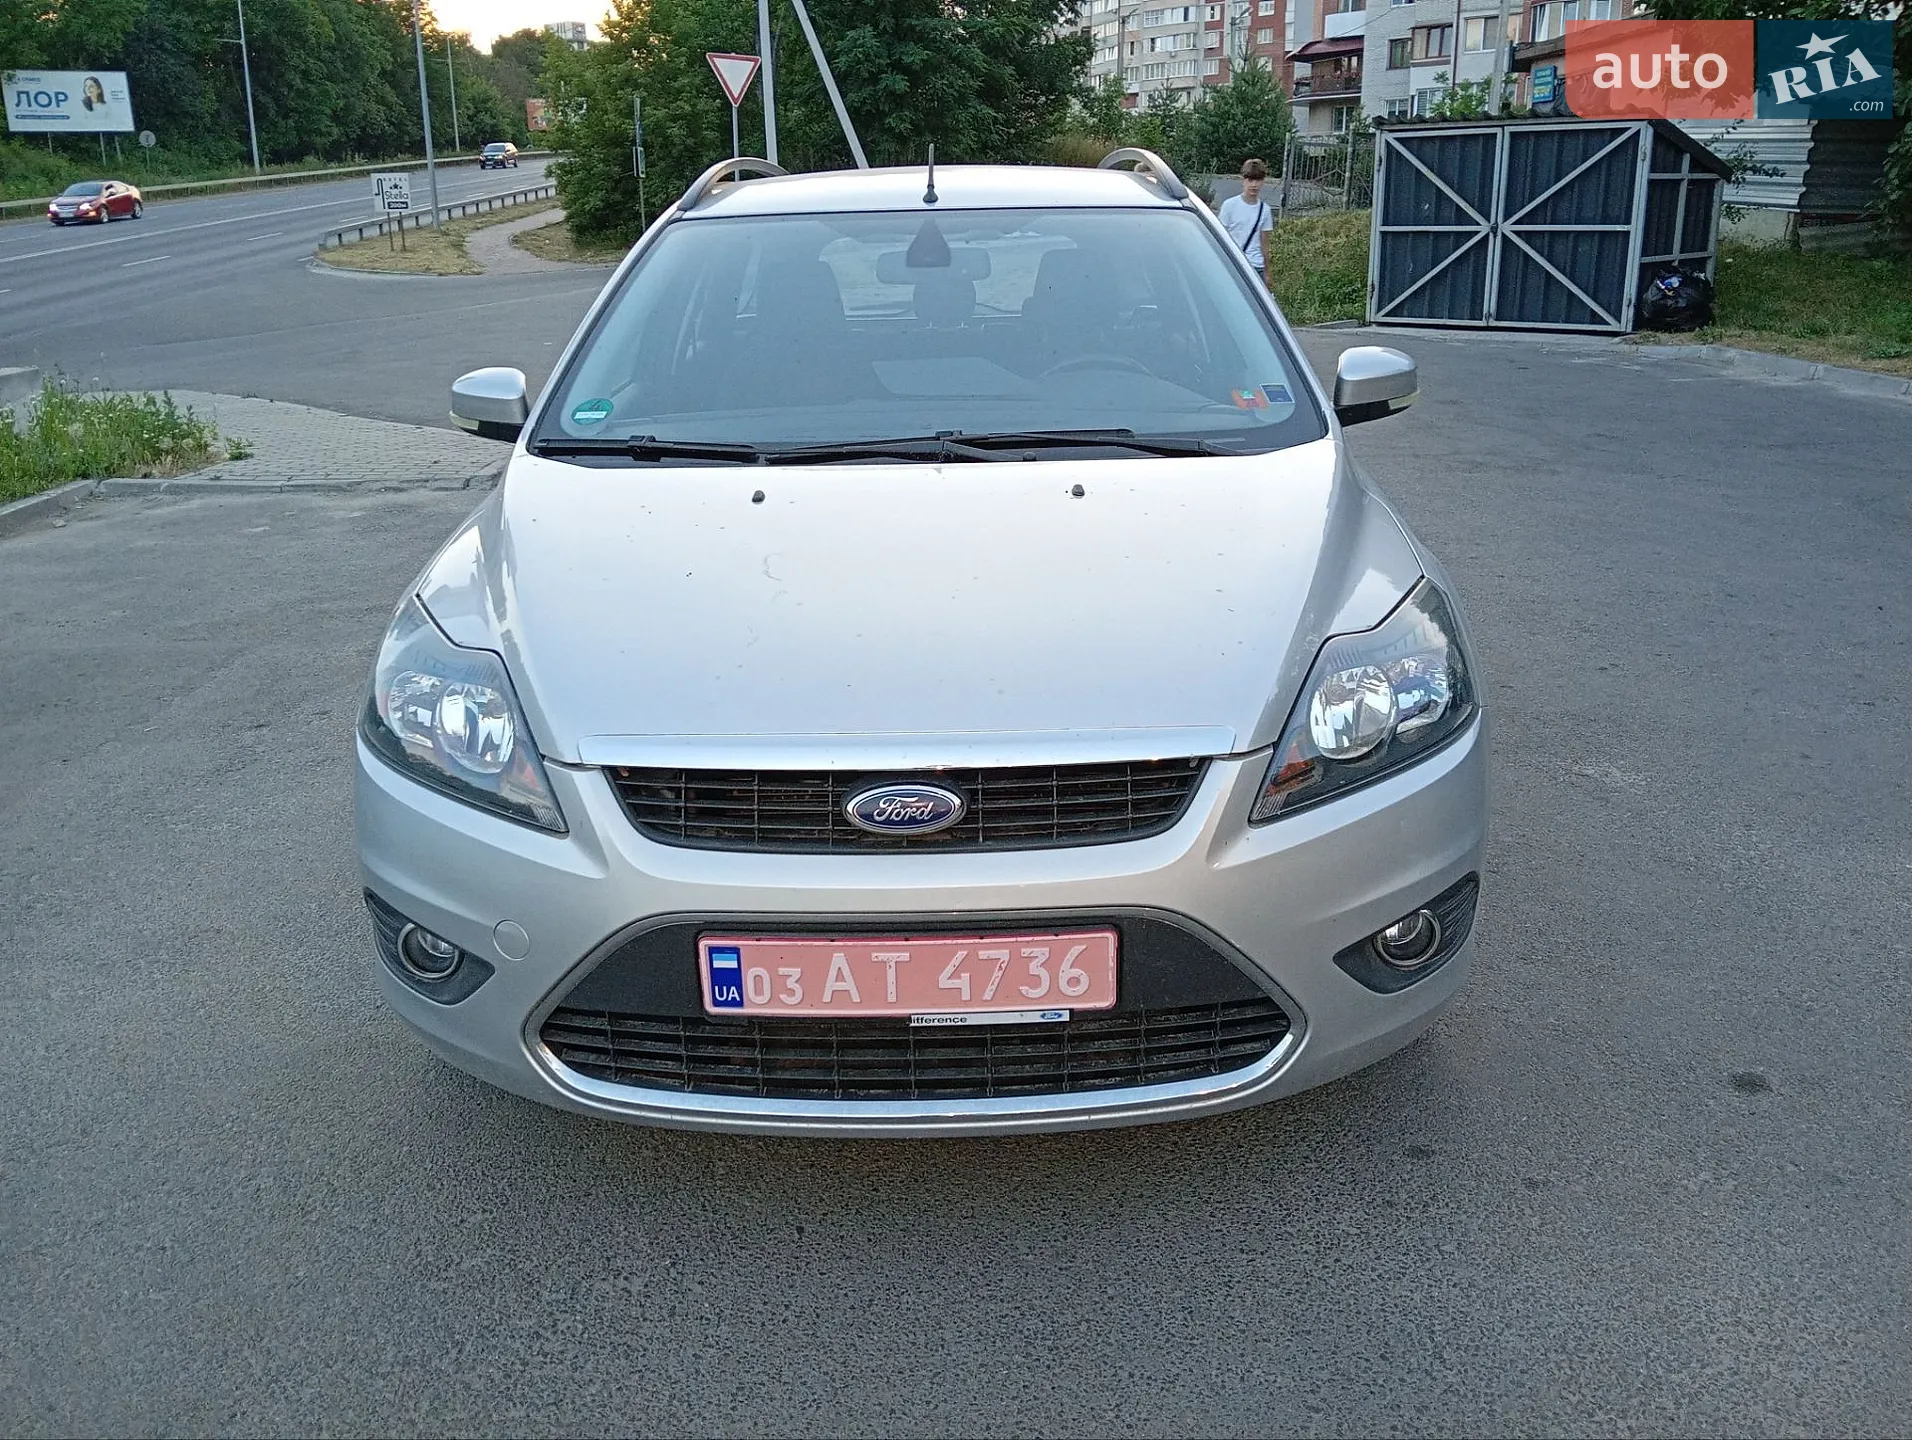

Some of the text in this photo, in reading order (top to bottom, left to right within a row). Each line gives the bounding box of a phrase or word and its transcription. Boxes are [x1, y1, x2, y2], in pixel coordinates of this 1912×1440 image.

[15, 90, 69, 108] ЛОР
[384, 190, 409, 200] Stella
[873, 796, 935, 822] Ford
[746, 944, 1090, 1006] 03 AT 4736
[714, 985, 741, 1001] UA
